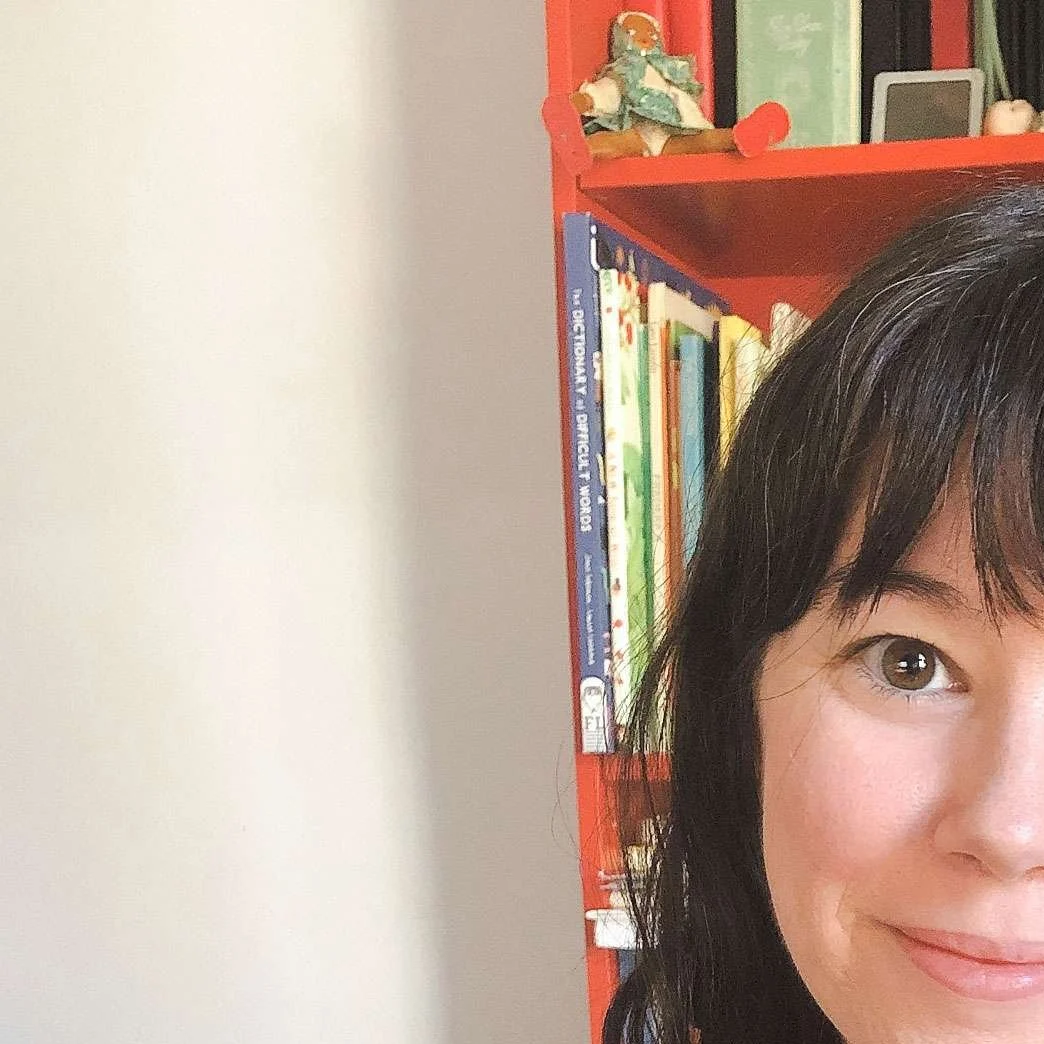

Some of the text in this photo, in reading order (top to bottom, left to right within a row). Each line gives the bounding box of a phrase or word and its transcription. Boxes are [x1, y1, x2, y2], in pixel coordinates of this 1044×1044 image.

[572, 309, 588, 397] DICTIONARY
[576, 413, 591, 481] DIFFICULT
[579, 485, 593, 533] WORDS
